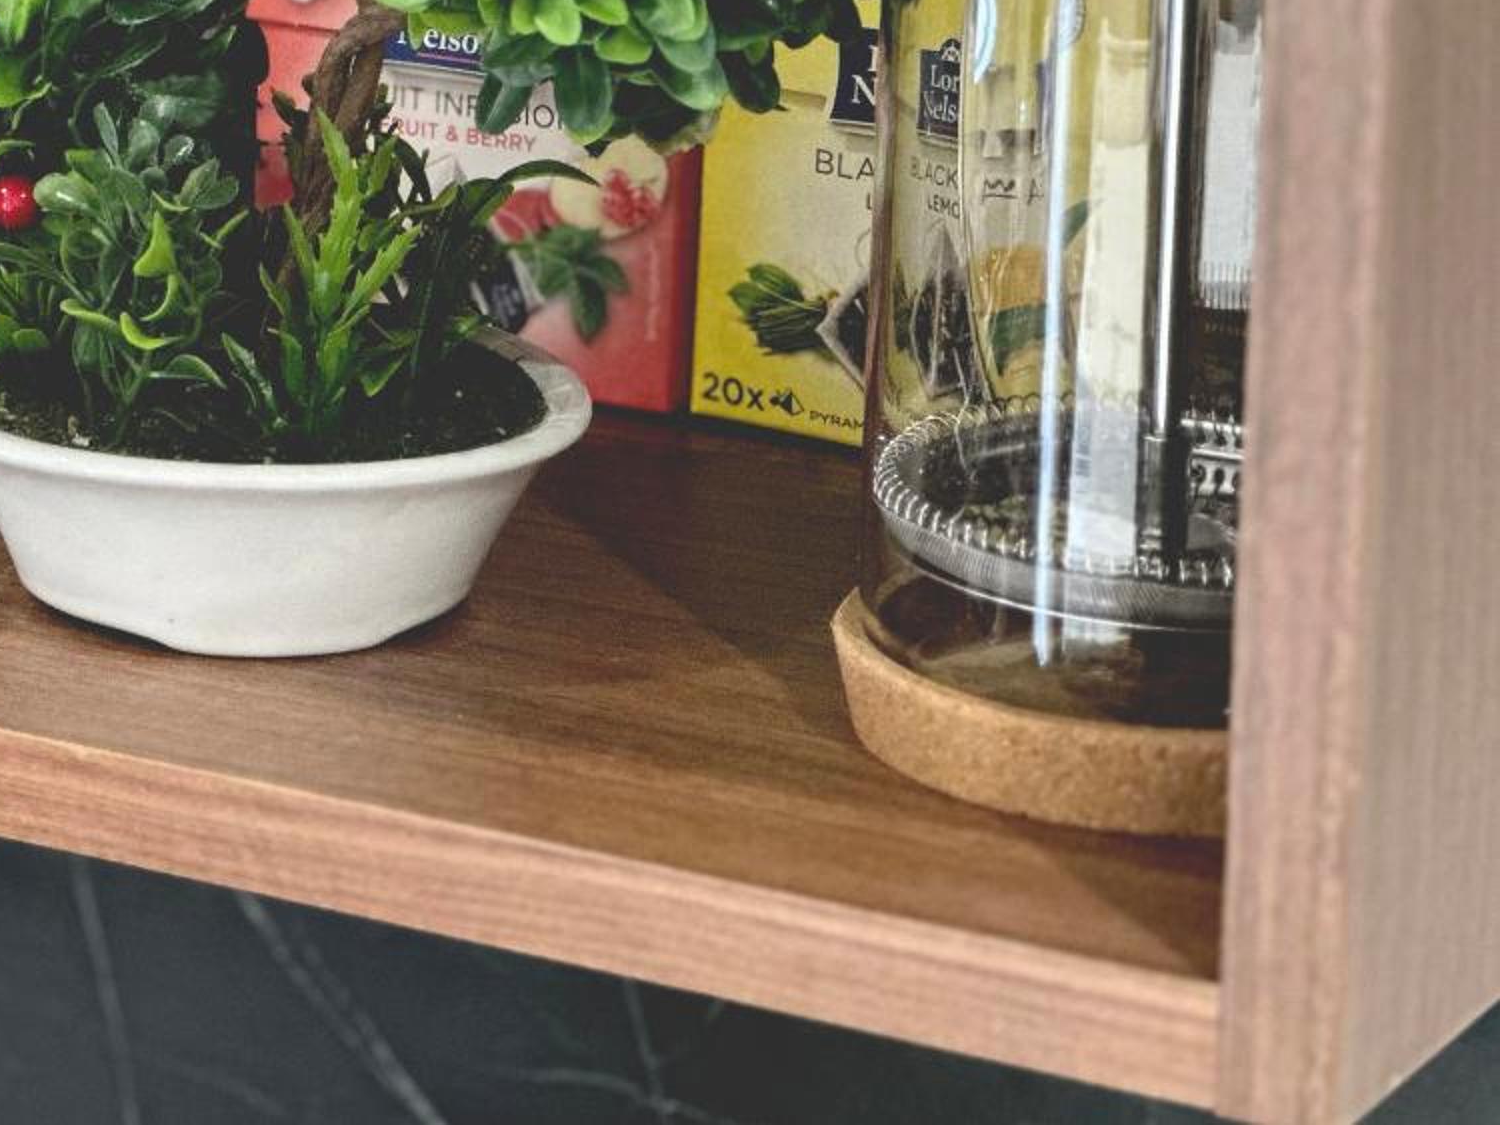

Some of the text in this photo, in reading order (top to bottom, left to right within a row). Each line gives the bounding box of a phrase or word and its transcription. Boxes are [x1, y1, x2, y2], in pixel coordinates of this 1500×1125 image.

[931, 64, 960, 92] Lor
[435, 90, 564, 130] INFIO
[923, 91, 957, 123] Nels
[466, 127, 537, 153] BERRY
[815, 148, 875, 180] BLA
[927, 193, 961, 219] LEMO
